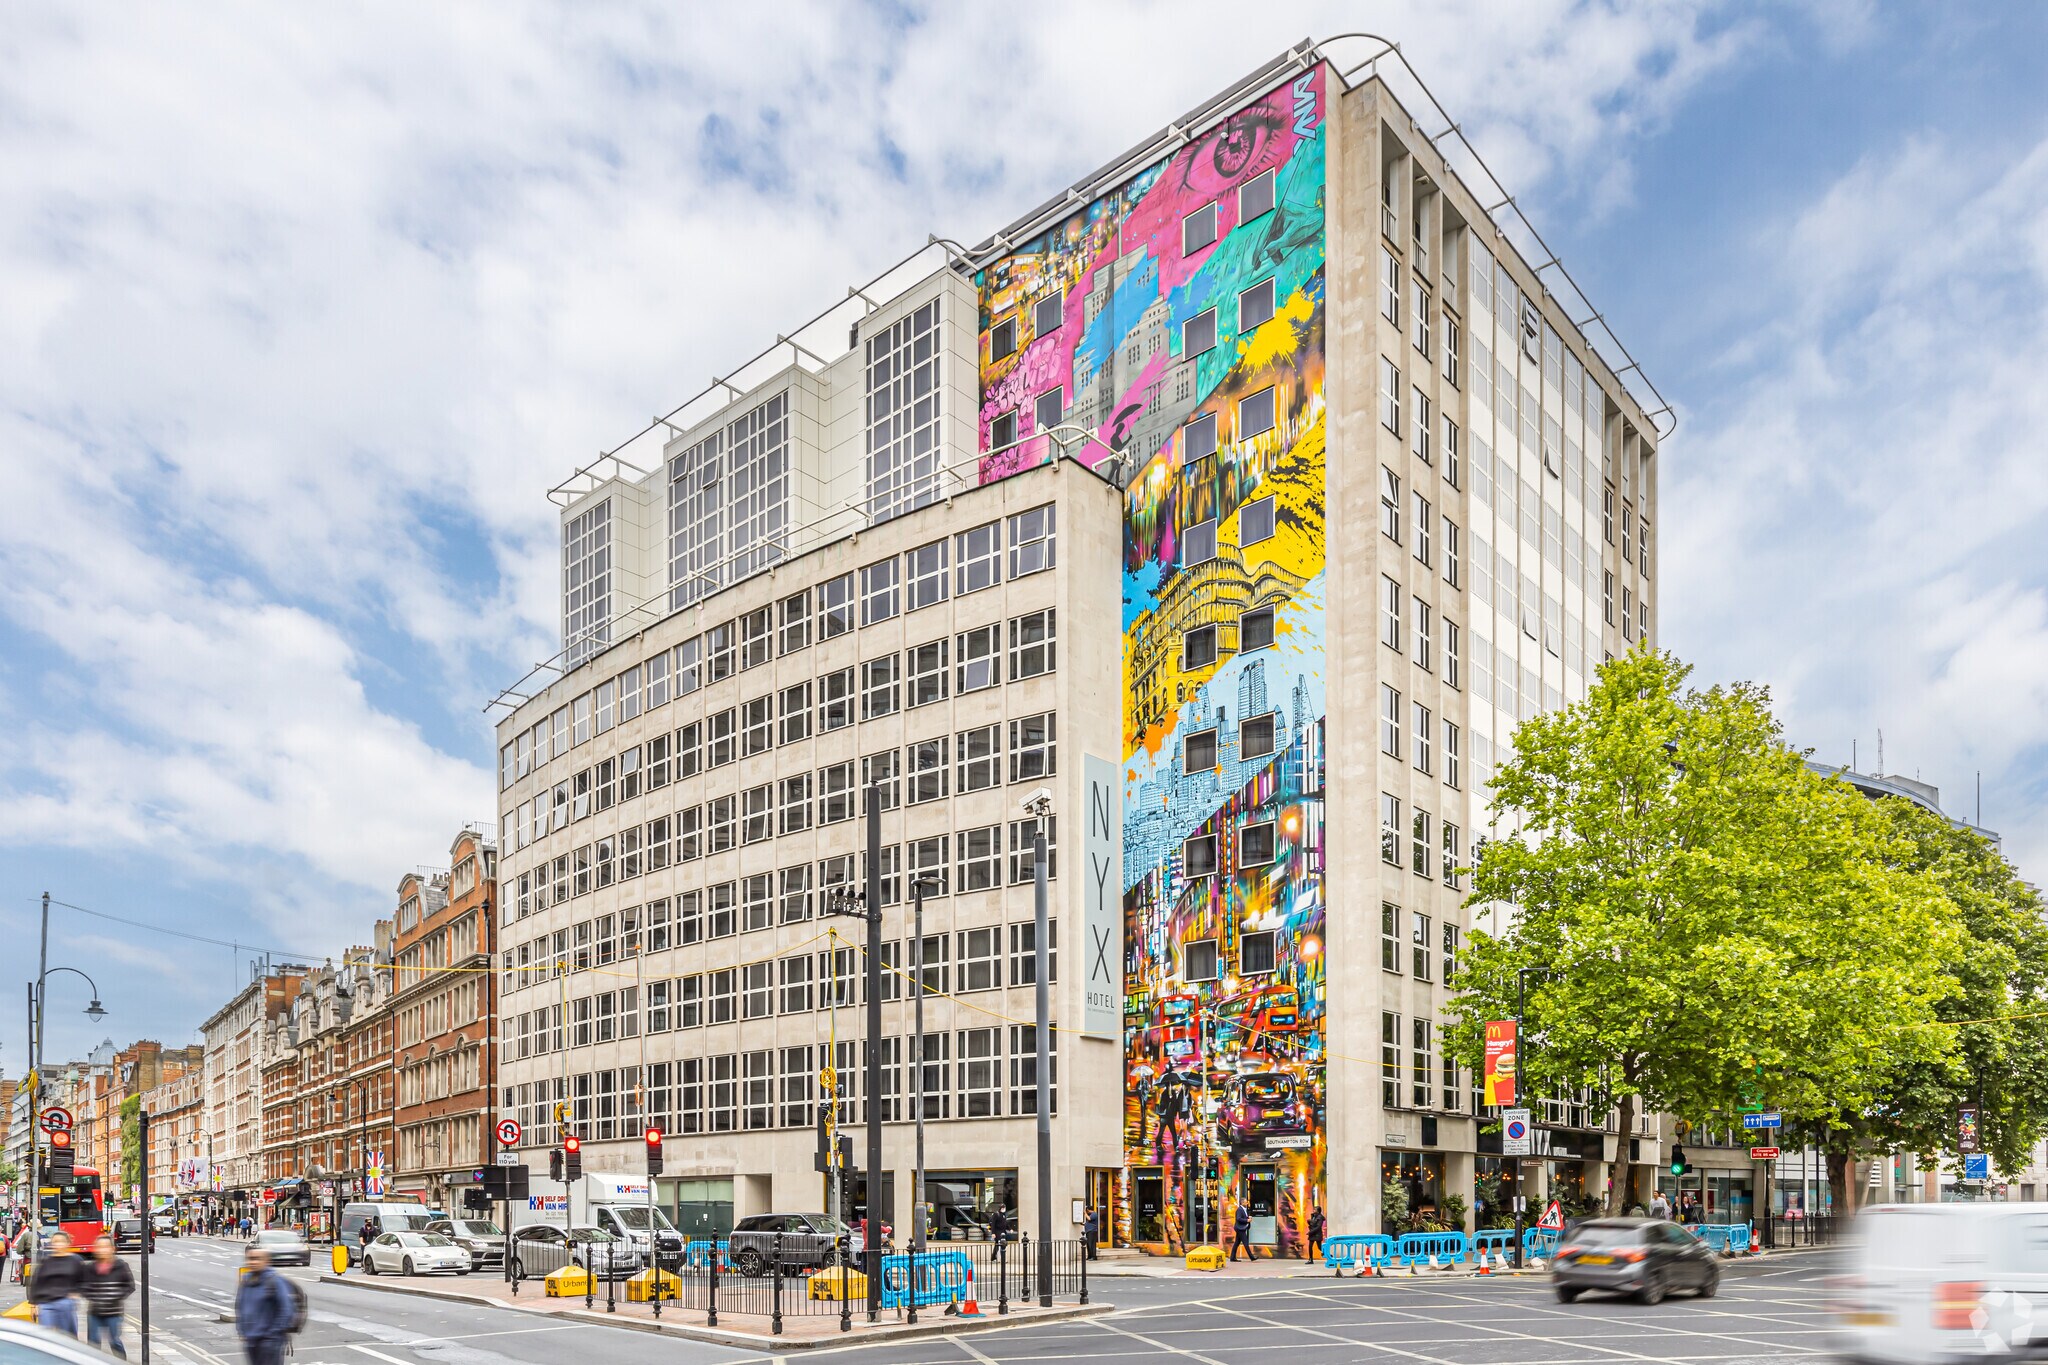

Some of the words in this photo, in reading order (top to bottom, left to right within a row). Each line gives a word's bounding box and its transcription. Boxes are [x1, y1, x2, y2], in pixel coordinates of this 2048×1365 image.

[1092, 780, 1111, 984] NYX
[1087, 991, 1115, 1009] HOTEL
[1486, 1038, 1514, 1048] Hungry?
[544, 1202, 556, 1210] VAN
[814, 1281, 832, 1292] SRL
